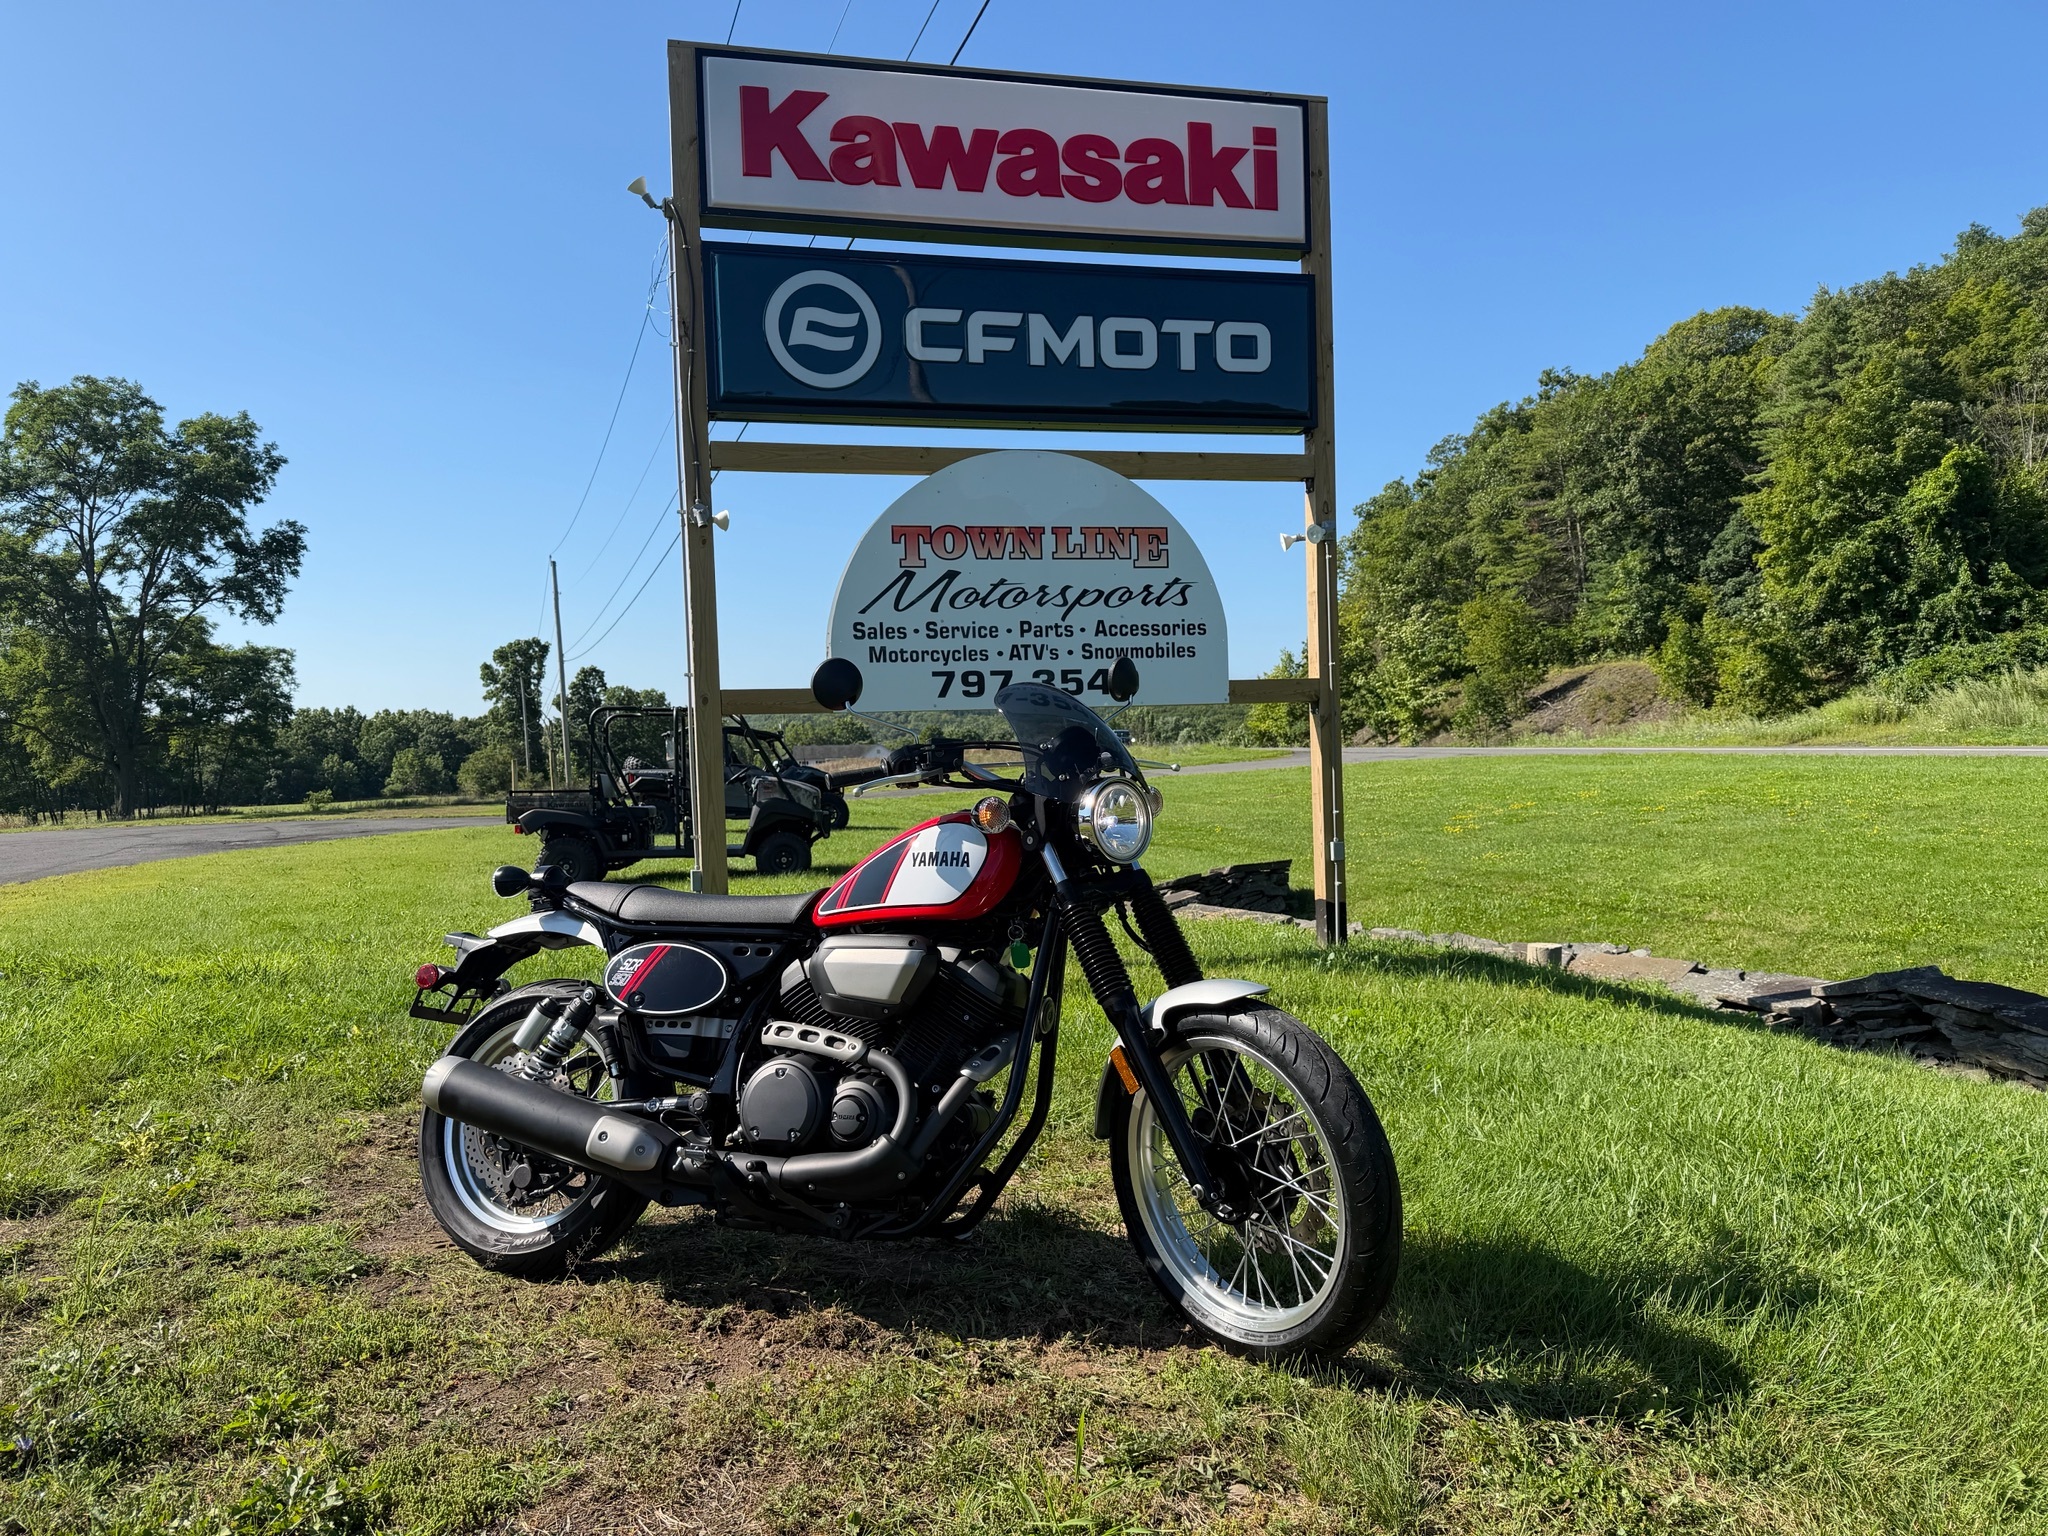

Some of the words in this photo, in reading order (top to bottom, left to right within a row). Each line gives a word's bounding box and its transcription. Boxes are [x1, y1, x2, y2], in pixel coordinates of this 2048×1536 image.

[739, 85, 1278, 211] Kawasaki
[904, 307, 1272, 374] CFMOTO
[891, 525, 1045, 568] TOWN
[1051, 526, 1169, 568] LINE
[858, 569, 1199, 622] Motorsports
[853, 622, 907, 640] Sales
[925, 621, 999, 639] Service
[1019, 620, 1074, 638] Parts
[1094, 619, 1207, 637] Accessories
[869, 645, 989, 666] Motorcycles
[1008, 644, 1059, 660] ATV's
[1081, 642, 1196, 660] Snowmobiles
[912, 851, 970, 868] YAMAHA
[619, 958, 645, 971] SCR
[511, 1231, 551, 1247] AVON
